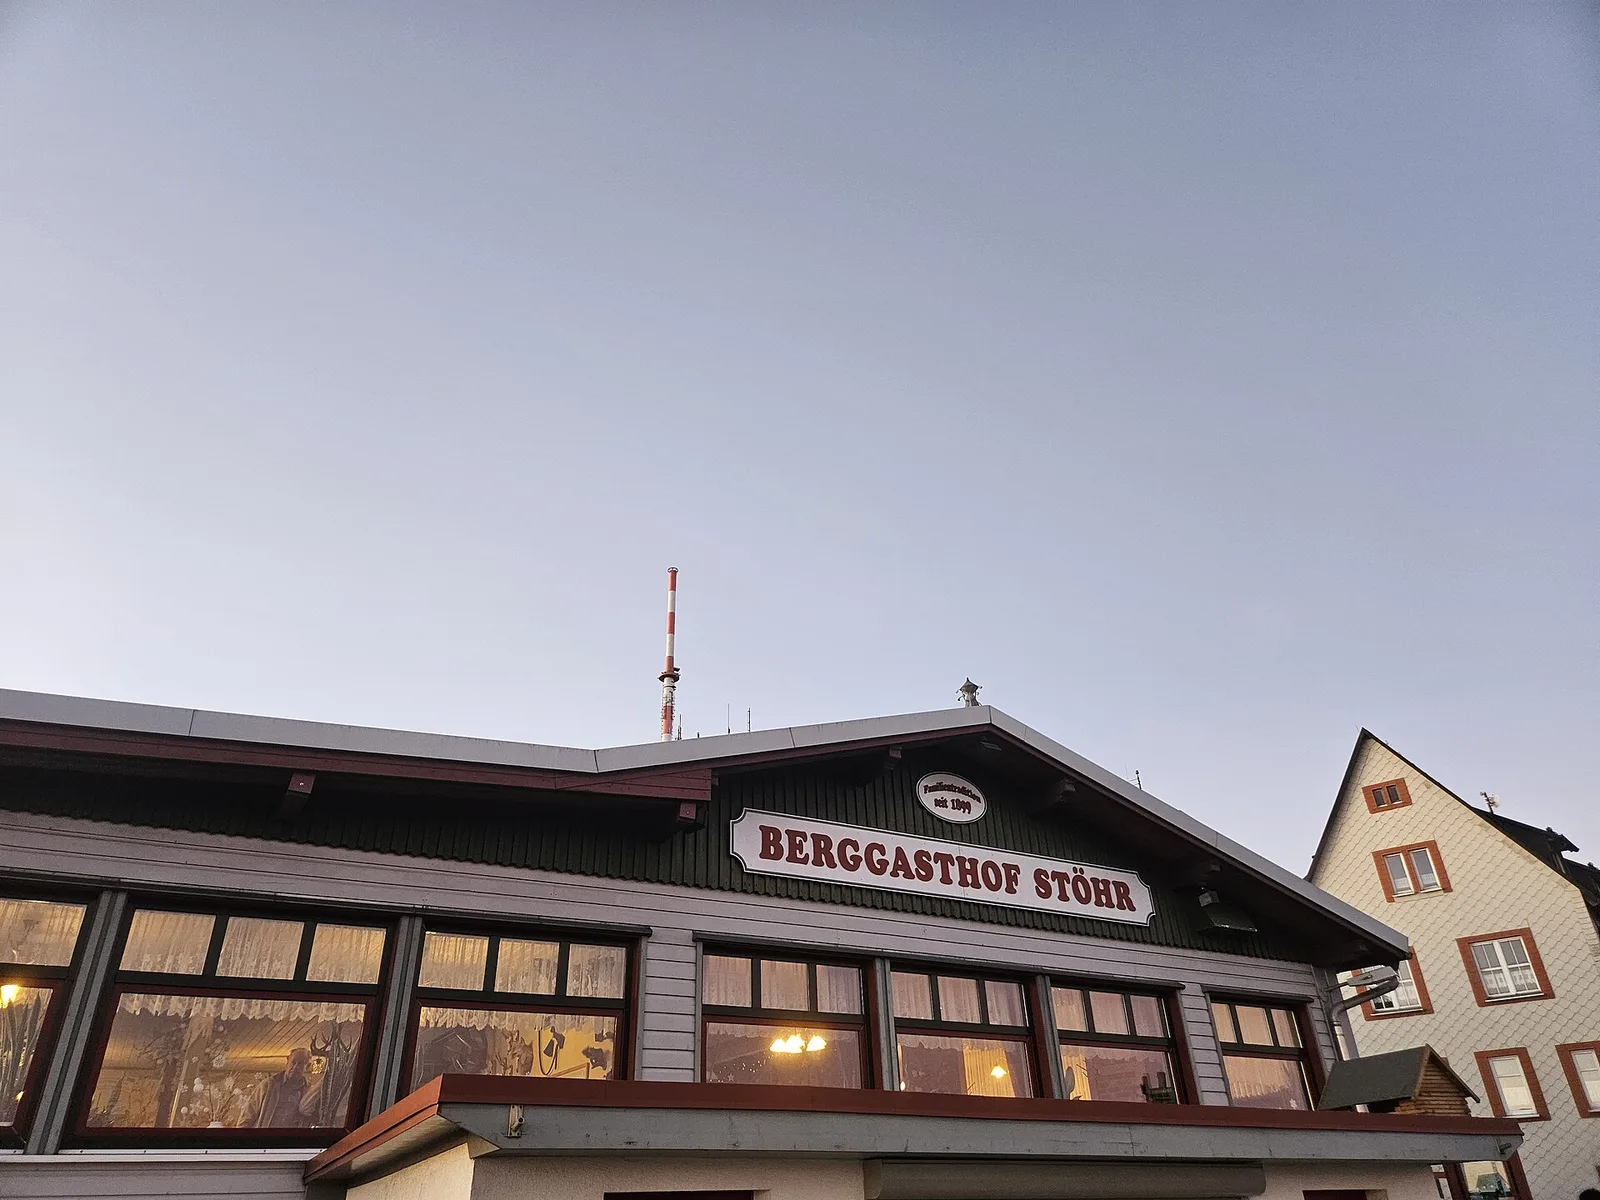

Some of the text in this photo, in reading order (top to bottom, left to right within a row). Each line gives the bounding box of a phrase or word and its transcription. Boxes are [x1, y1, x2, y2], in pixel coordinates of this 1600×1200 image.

[933, 797, 948, 809] seit
[759, 824, 1137, 912] BERGGASTHOF STÖHR
